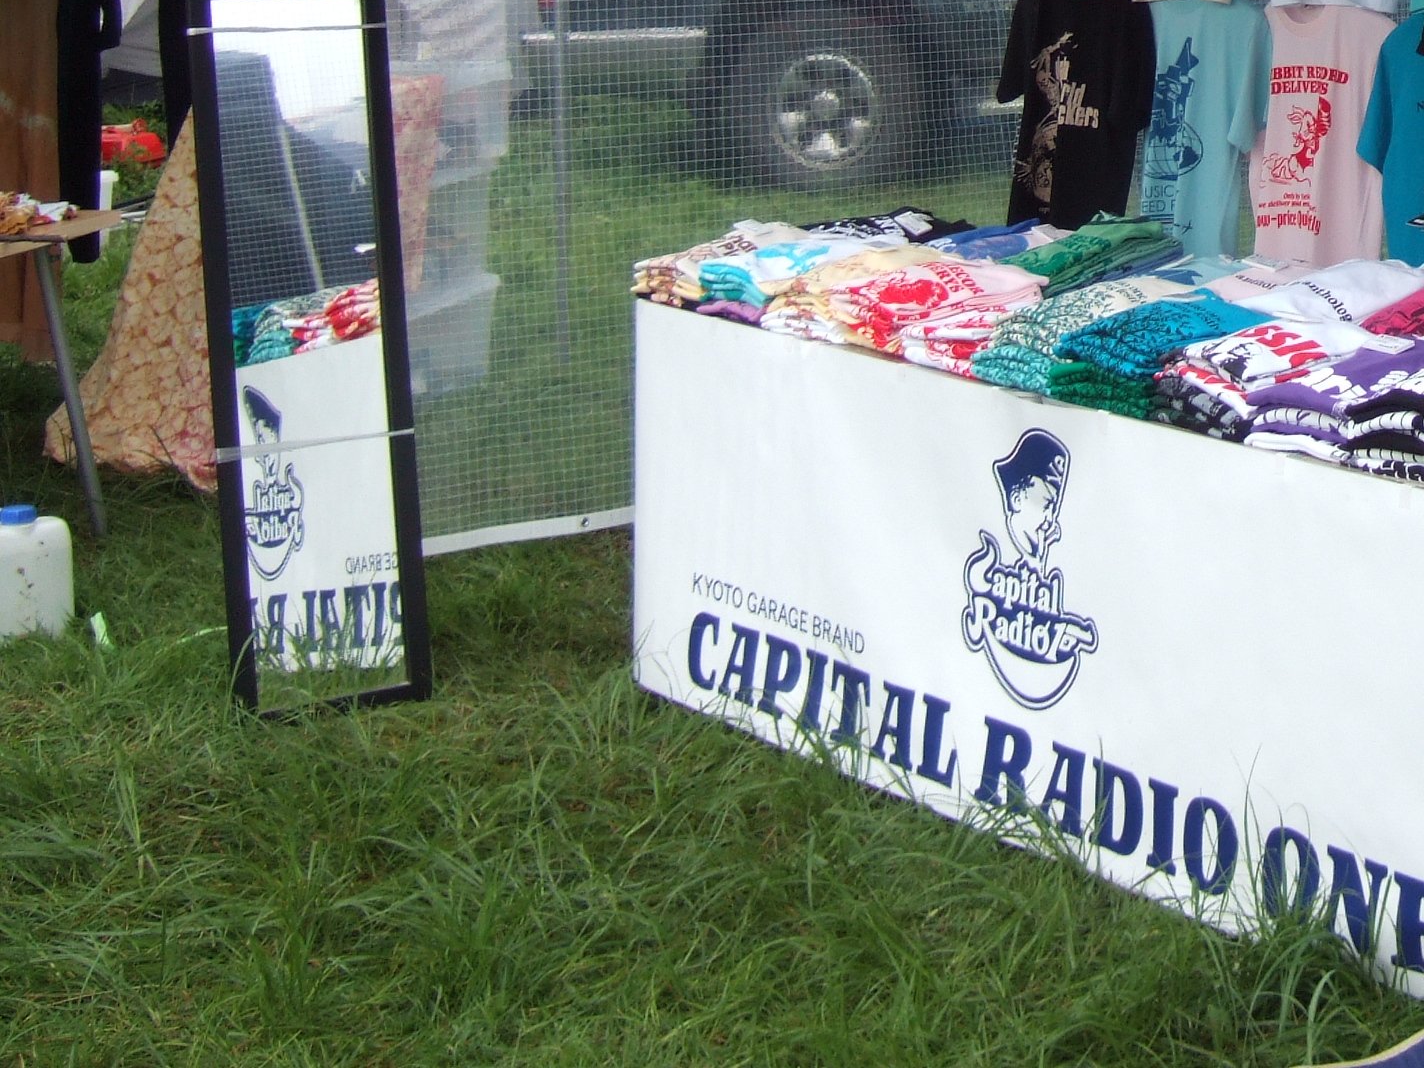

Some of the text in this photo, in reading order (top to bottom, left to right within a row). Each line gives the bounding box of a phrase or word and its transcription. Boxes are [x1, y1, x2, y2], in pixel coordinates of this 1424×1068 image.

[692, 572, 865, 654] KYOTO GARAGE BRAND
[968, 534, 1060, 615] Capital
[688, 611, 957, 789] CAPITAL
[974, 714, 1239, 894] RADIO
